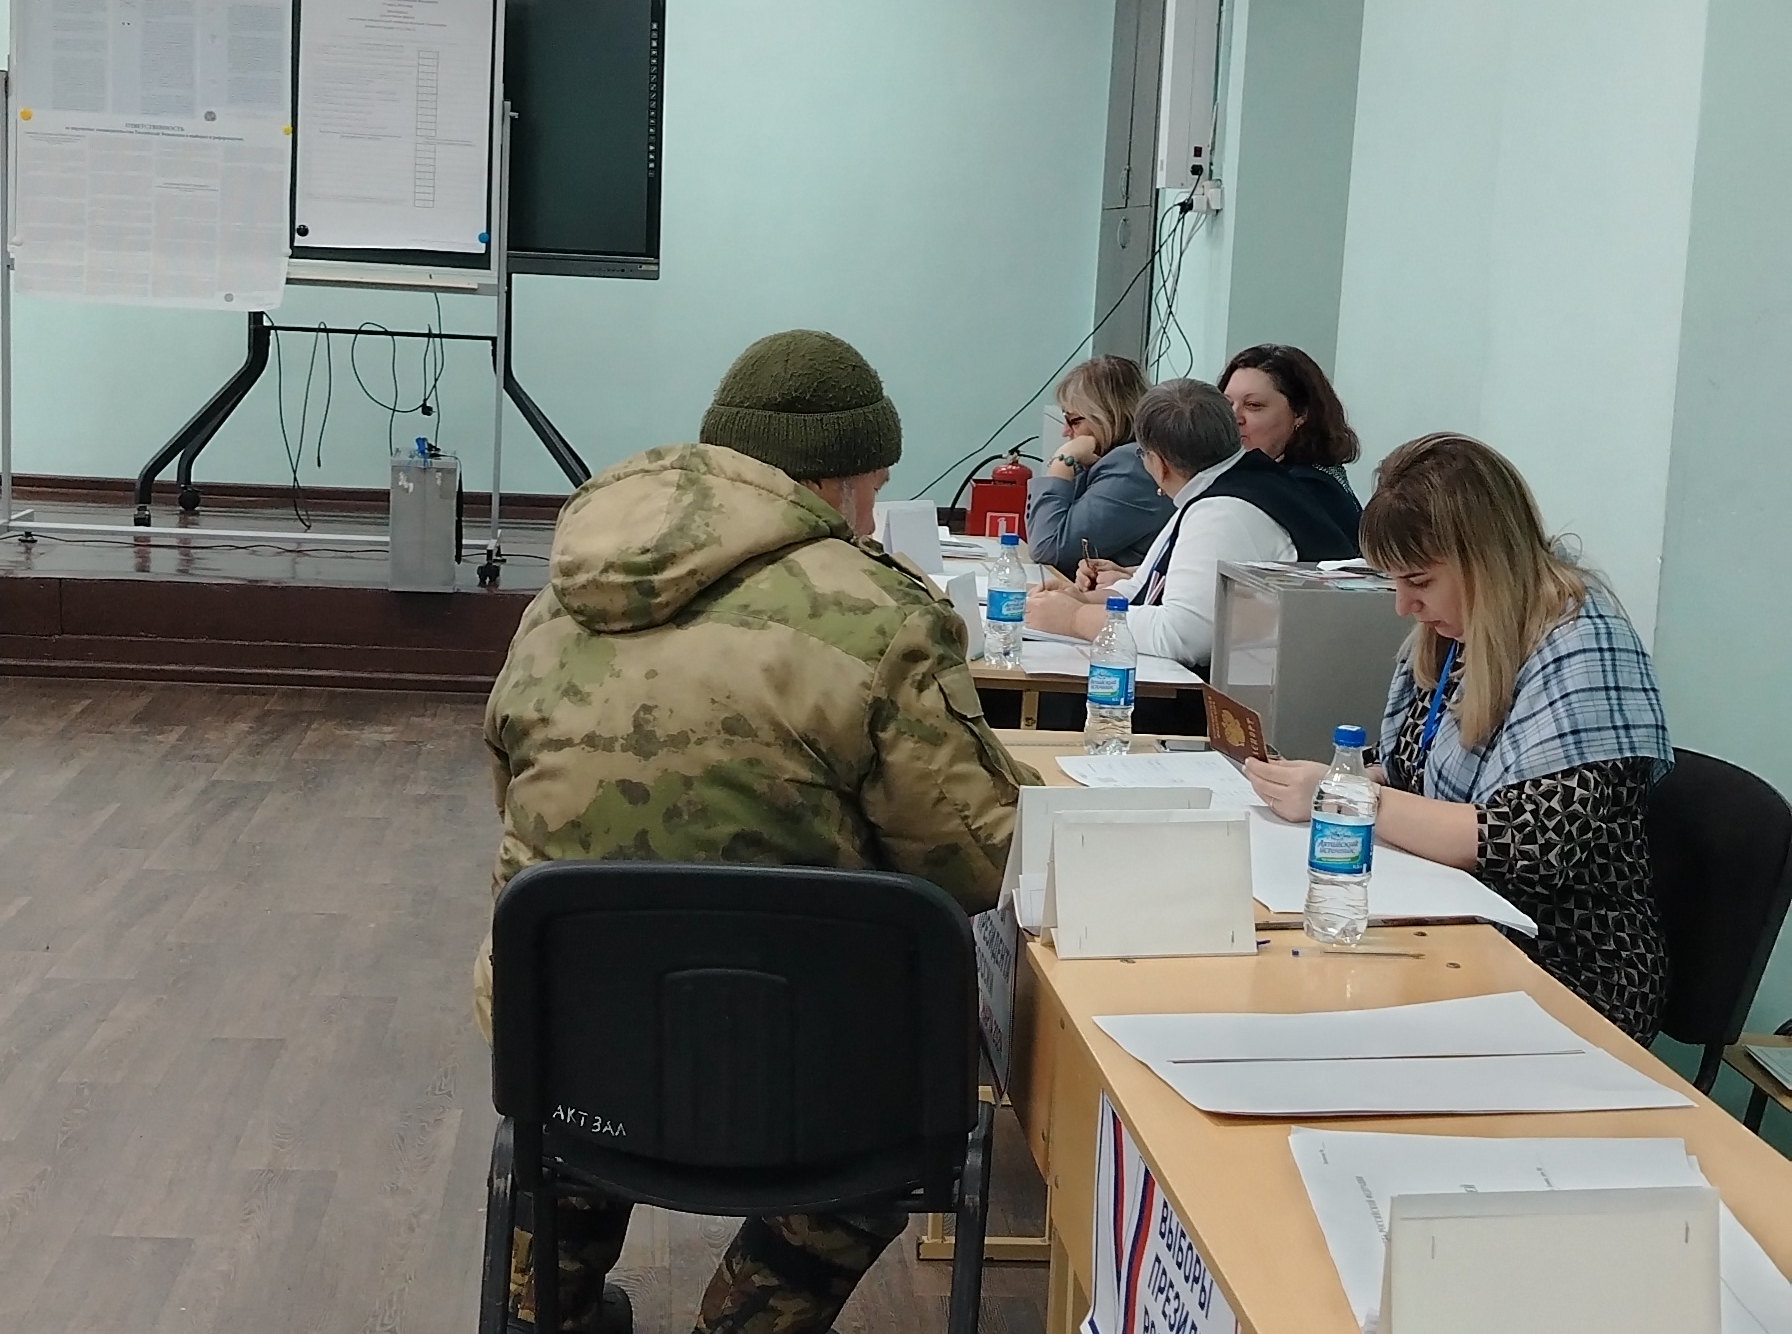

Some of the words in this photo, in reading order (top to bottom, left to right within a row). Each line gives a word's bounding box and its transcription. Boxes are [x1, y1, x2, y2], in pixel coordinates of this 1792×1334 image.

[552, 1104, 589, 1127] АКТ
[591, 1116, 627, 1137] ЗАЛ
[1158, 1198, 1214, 1320] ВЫБОРЫ
